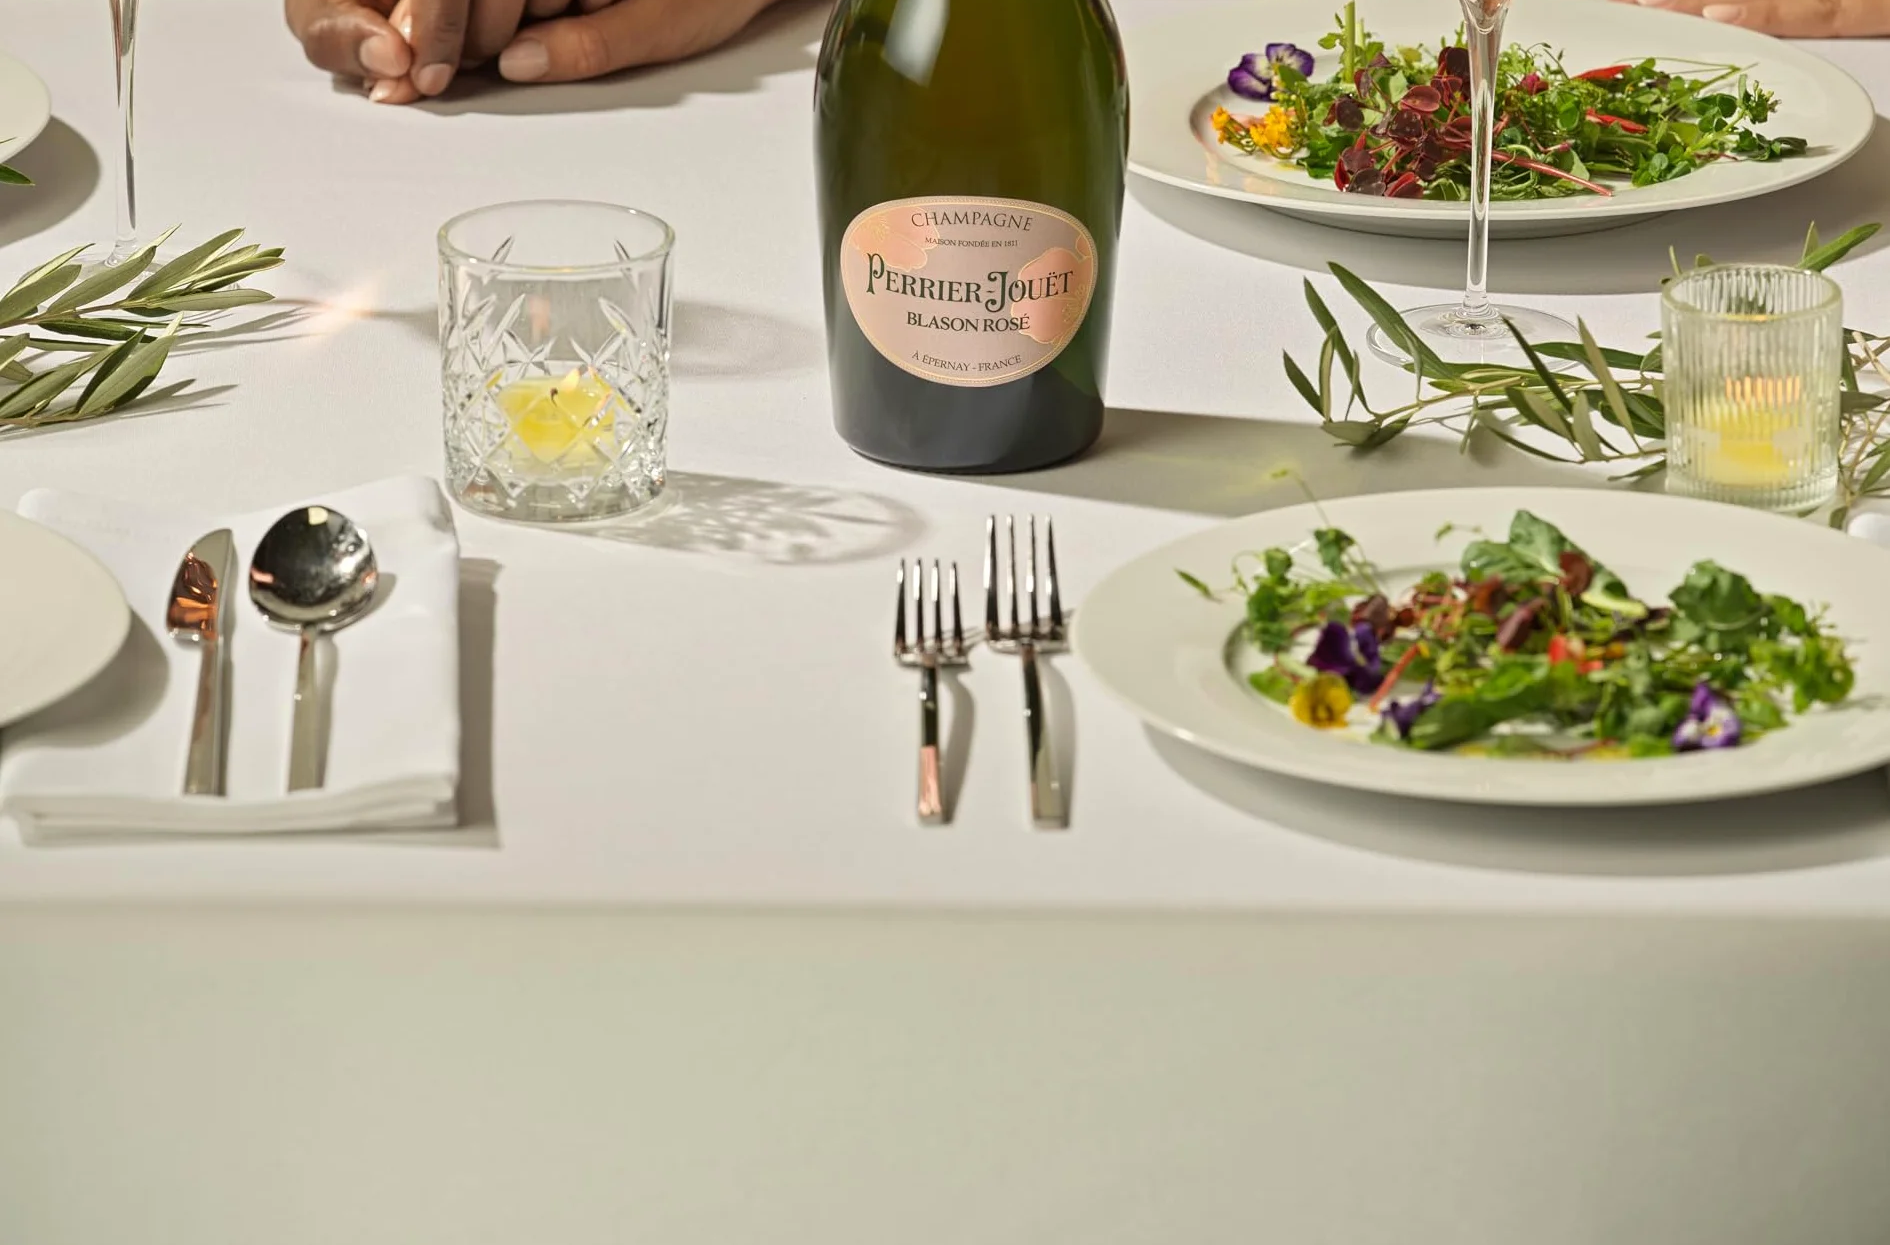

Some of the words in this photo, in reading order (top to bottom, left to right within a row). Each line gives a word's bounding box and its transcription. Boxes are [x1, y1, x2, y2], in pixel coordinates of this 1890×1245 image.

[911, 211, 1033, 231] CHAMPAGNE
[925, 237, 957, 246] MAISON
[958, 239, 989, 248] FONDÉE
[1004, 239, 1018, 247] 1811
[866, 252, 1074, 313] PERRIER-JOUËT
[906, 311, 980, 332] BLASON
[983, 313, 1031, 332] ROSÉ
[978, 354, 1022, 371] FRANCE
